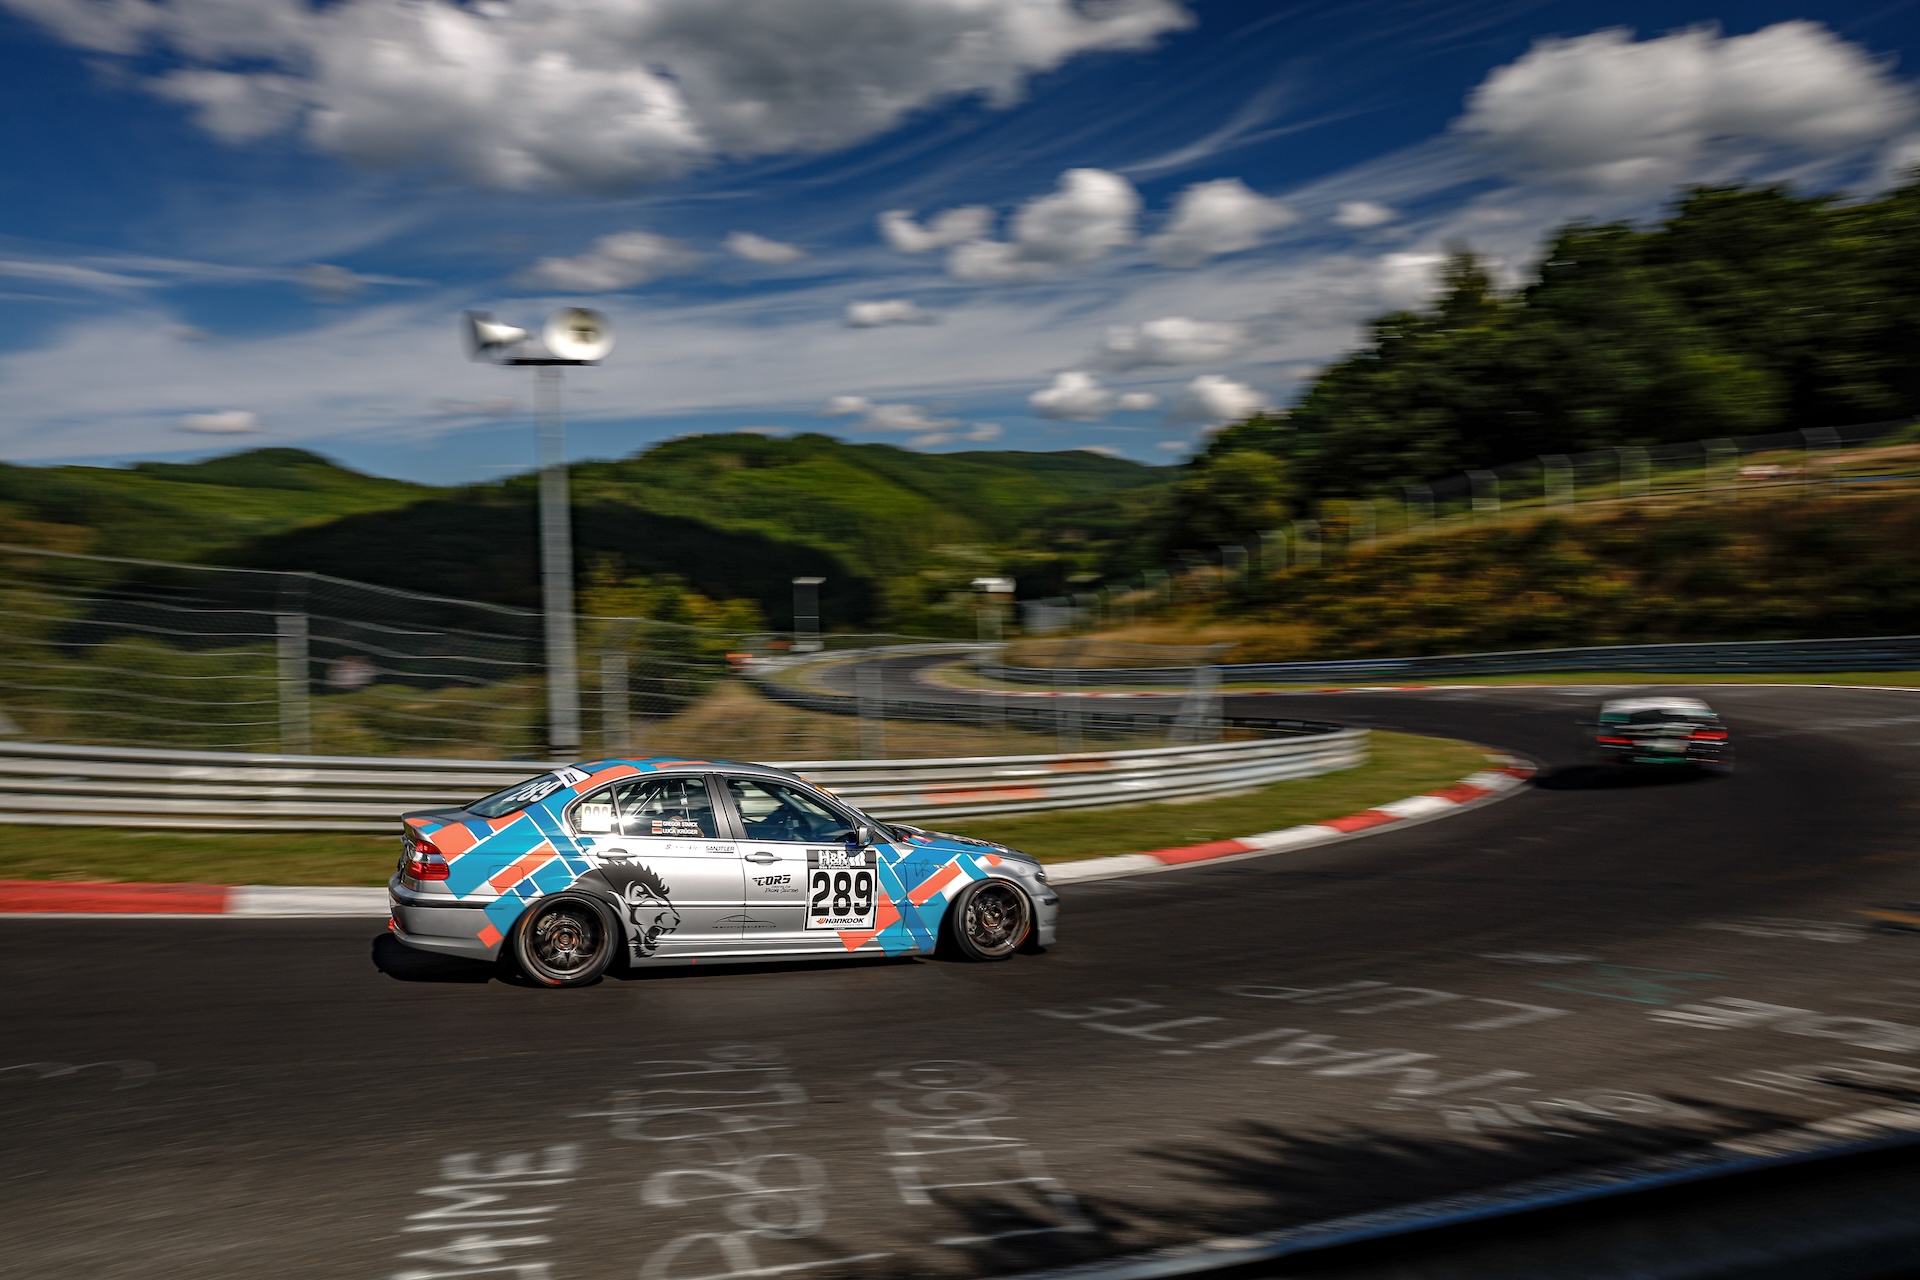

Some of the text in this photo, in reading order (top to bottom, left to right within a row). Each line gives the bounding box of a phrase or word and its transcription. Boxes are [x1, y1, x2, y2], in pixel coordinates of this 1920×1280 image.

[502, 780, 563, 803] 289
[817, 849, 850, 866] H&R
[811, 871, 873, 917] 289
